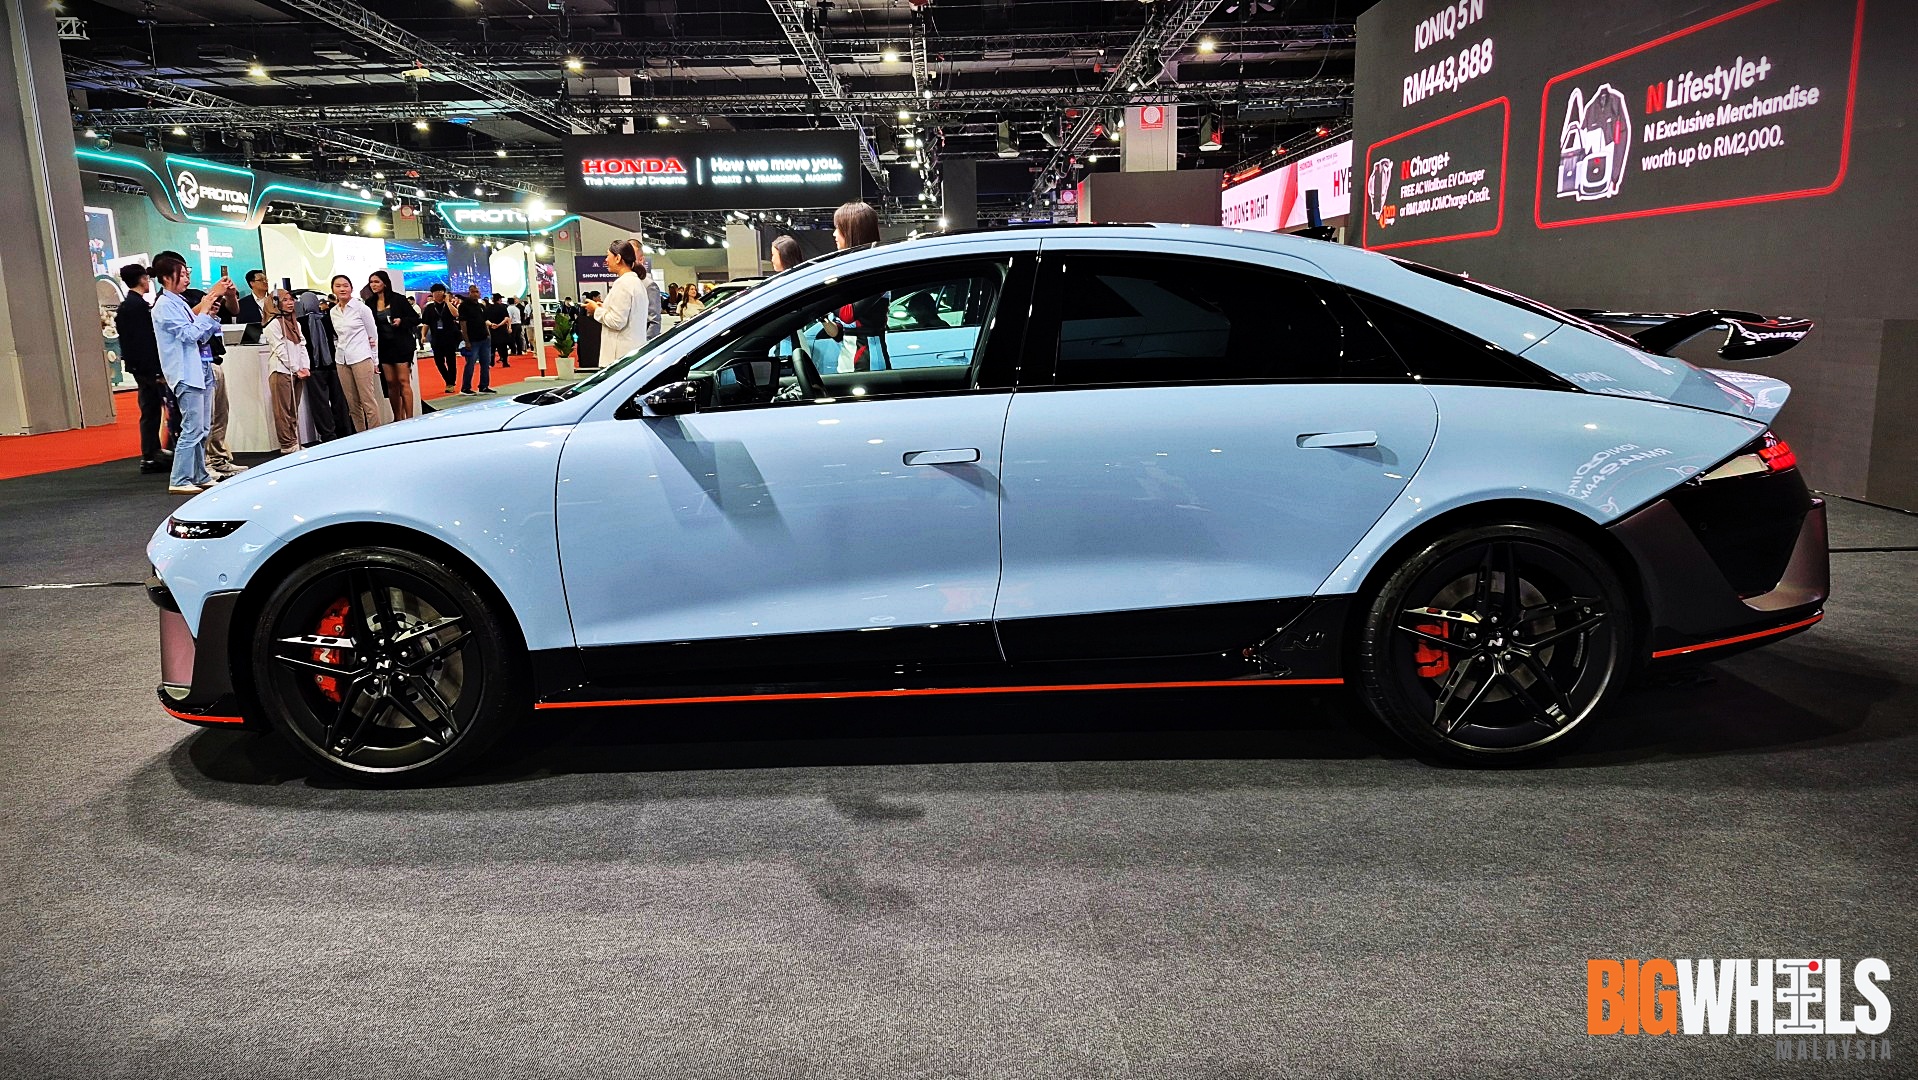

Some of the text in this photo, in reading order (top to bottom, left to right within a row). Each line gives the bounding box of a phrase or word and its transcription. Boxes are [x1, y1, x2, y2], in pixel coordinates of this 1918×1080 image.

[1414, 0, 1484, 53] IONIQ 5 N
[1402, 37, 1493, 108] RM443,888
[1665, 55, 1772, 109] Lifestyle+
[1643, 84, 1820, 143] N Exclusive Merchandise
[1641, 124, 1785, 171] worth up to RM2,000.
[581, 157, 688, 175] HONDA
[710, 157, 843, 173] How we move you.
[1410, 152, 1450, 177] Charge+
[583, 175, 688, 186] The Power of Dreams
[1400, 168, 1486, 199] FREE AC Wallbox EV Charger
[199, 185, 249, 205] PROTON
[1250, 194, 1269, 220] RIGHT
[1399, 206, 1406, 217] or
